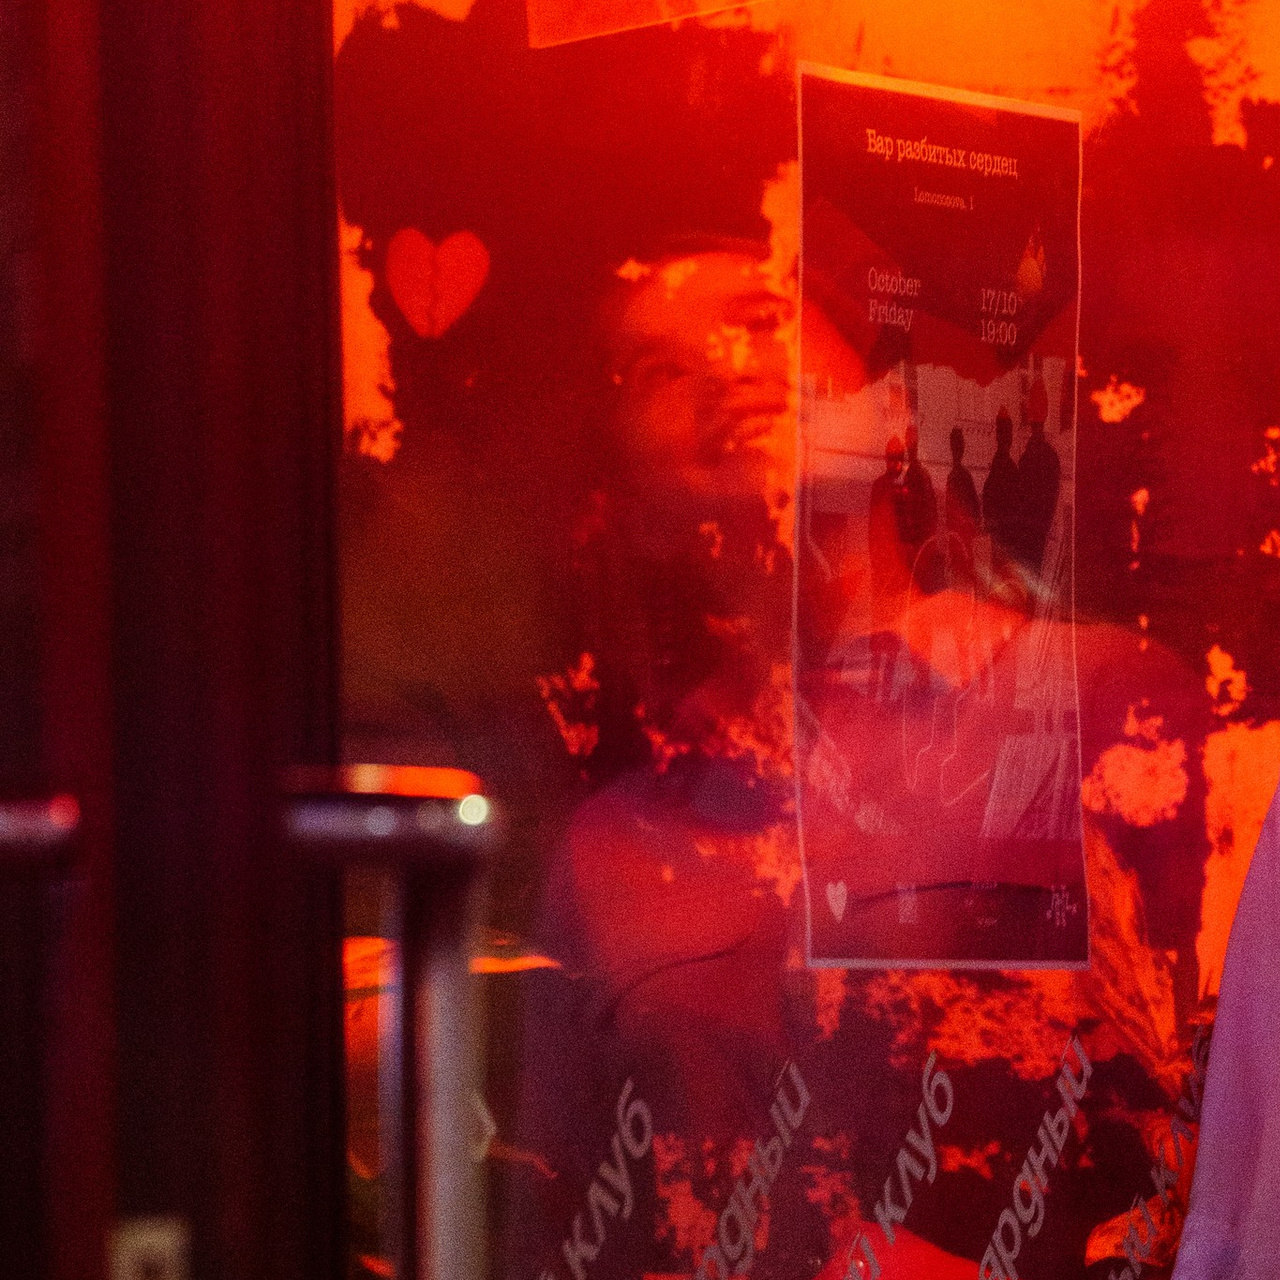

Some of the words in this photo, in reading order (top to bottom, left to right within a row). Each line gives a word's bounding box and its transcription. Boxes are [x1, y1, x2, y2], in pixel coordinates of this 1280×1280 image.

[866, 128, 893, 160] Бар
[896, 136, 966, 168] разбитых
[969, 151, 1018, 180] сердец
[868, 267, 921, 297] October
[868, 298, 914, 333] Friday
[981, 288, 1018, 318] 17/10
[874, 1050, 955, 1248] клуб
